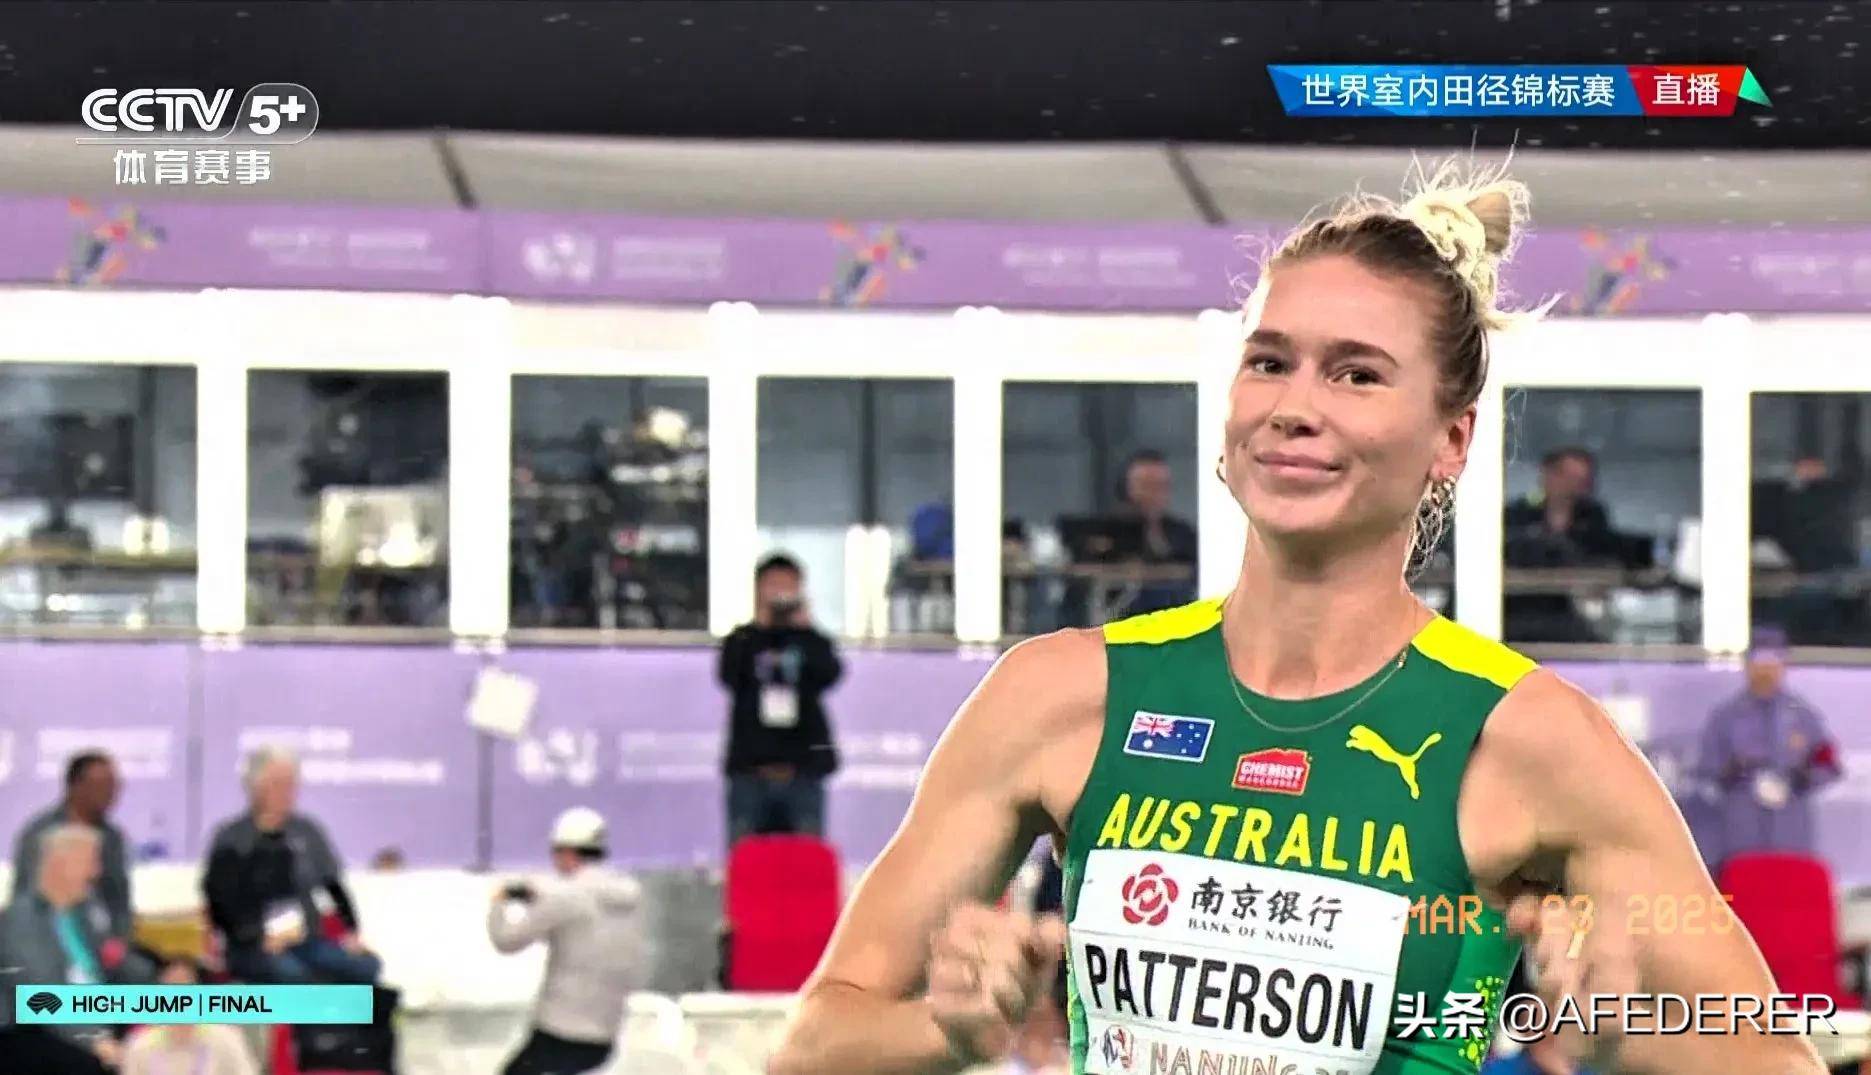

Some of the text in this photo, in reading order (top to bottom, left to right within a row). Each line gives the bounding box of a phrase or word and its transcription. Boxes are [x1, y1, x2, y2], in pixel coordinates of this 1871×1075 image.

[1240, 760, 1305, 780] CHEMIST
[1096, 792, 1414, 883] AUSTRALIA
[1190, 875, 1344, 933] 南京银行
[1188, 918, 1335, 951] BANK OF NANJING
[1084, 943, 1375, 1051] PATTERSON
